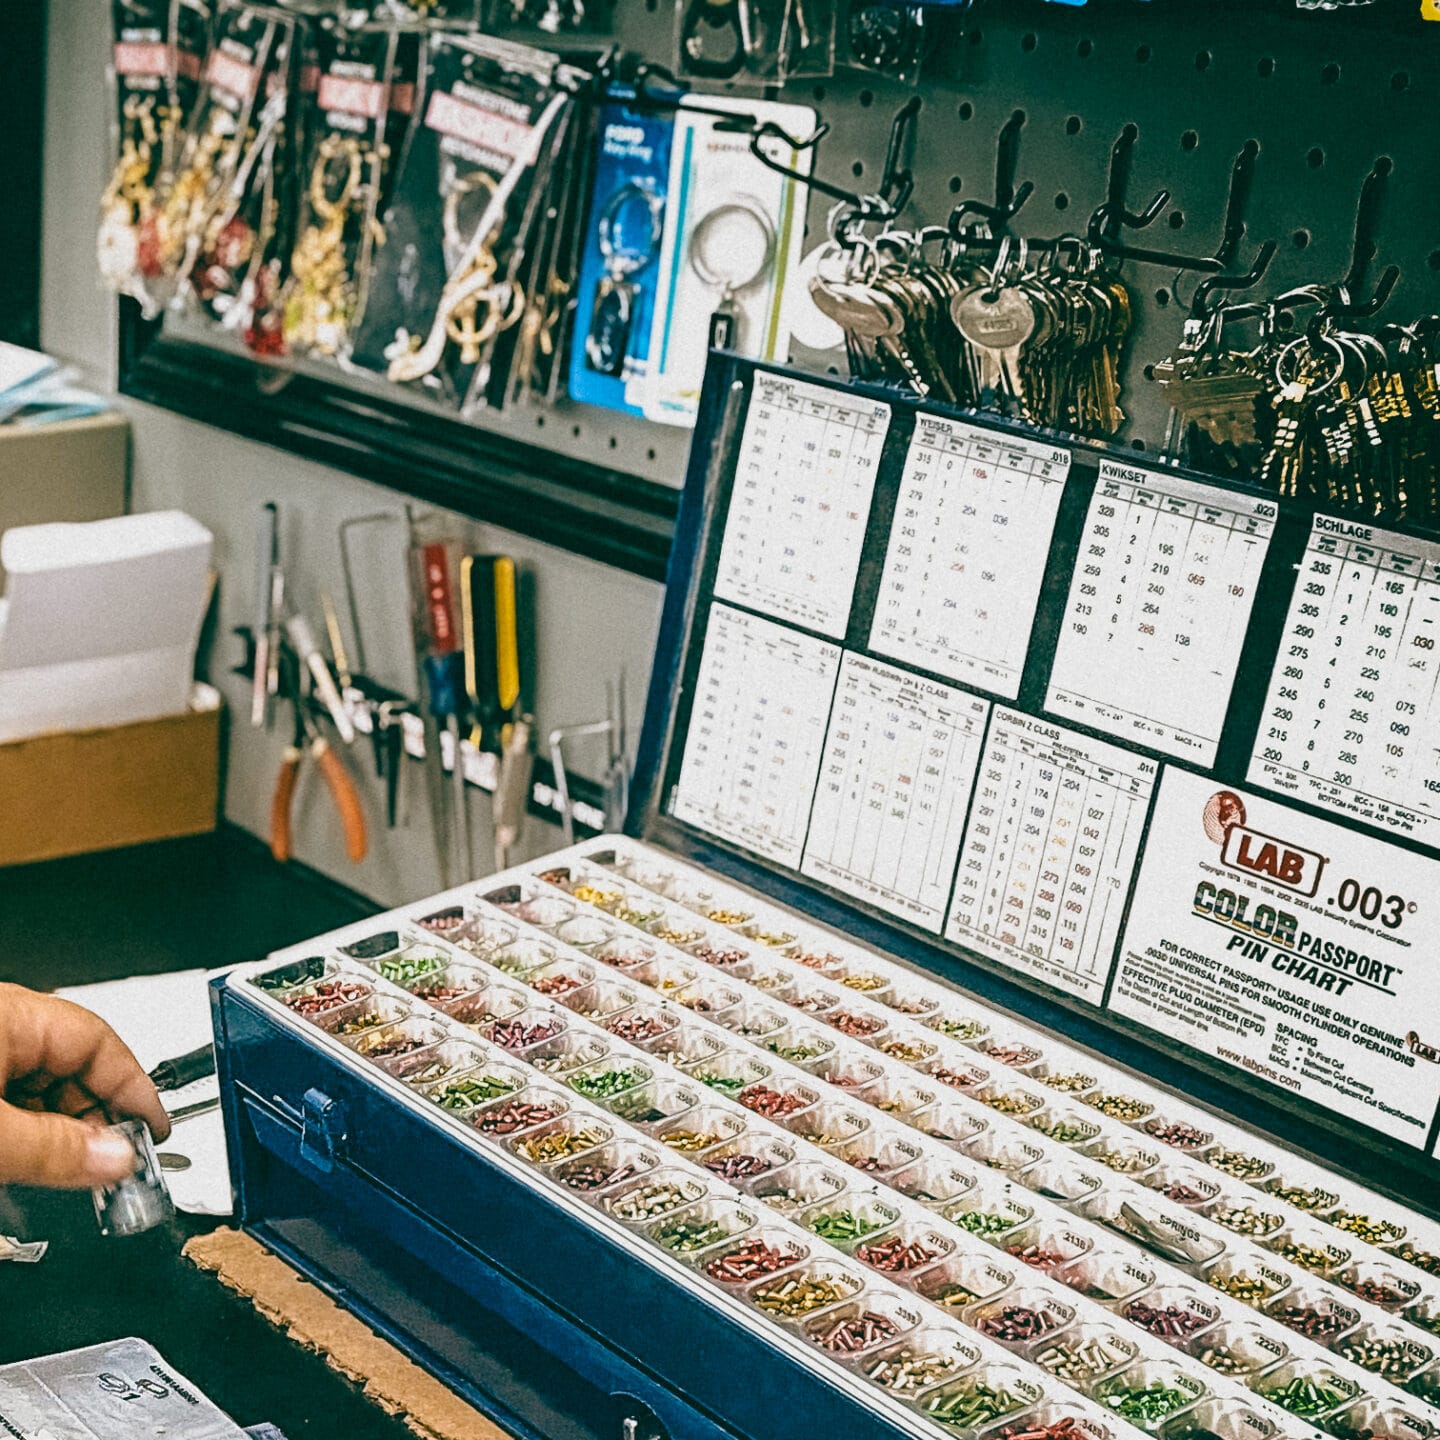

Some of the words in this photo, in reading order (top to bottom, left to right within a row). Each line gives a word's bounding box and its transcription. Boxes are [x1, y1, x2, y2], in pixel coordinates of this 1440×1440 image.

[920, 418, 953, 434] WEISER
[1101, 464, 1148, 485] KWIKSET
[1093, 525, 1110, 538] 305
[1315, 517, 1373, 542] SCHLAGE
[1151, 563, 1170, 576] 219
[1075, 603, 1092, 616] 213
[1072, 622, 1088, 635] 190
[1373, 624, 1392, 639] 195
[1365, 646, 1386, 660] 210
[1360, 667, 1380, 681] 225
[1033, 723, 1061, 741] CLASS
[1343, 731, 1364, 745] 270
[1338, 751, 1358, 765] 285
[1333, 772, 1352, 786] 300
[1236, 834, 1305, 884] LAB
[1193, 881, 1298, 949] COLOR
[1226, 935, 1268, 962] PIN
[1271, 953, 1354, 996] CHART
[1122, 966, 1168, 992] EFFECTIVE
[1169, 986, 1192, 1003] PLUG
[1194, 996, 1239, 1024] DIAMETER
[1240, 1016, 1265, 1036] (EPD)
[1160, 939, 1178, 953] FOR
[1180, 948, 1222, 971] CORRECT
[1277, 988, 1311, 1010] USAGE
[1312, 1002, 1331, 1018] USE
[1333, 1012, 1359, 1028] ONLY
[1360, 1023, 1405, 1048] GENUINE
[1416, 1045, 1437, 1060] LAB
[1169, 956, 1217, 984] UNIVERSAL
[1219, 977, 1239, 993] PINS
[1241, 987, 1260, 1001] FOR
[1262, 996, 1302, 1019] SMOOTH
[1303, 1013, 1350, 1040] CYLINDER
[1352, 1034, 1415, 1067] OPERATIONS
[1276, 1022, 1318, 1048] SPACING
[1271, 1044, 1287, 1056] BCC
[1333, 1071, 1346, 1082] Cut
[1274, 1034, 1290, 1046] TFC
[1315, 1052, 1331, 1064] First
[1332, 1059, 1345, 1070] Cut
[1217, 1046, 1301, 1090] www.labpins.com
[1269, 1054, 1291, 1069] MACS
[1333, 1084, 1363, 1102] Adjacent
[1364, 1096, 1378, 1107] Cut
[1378, 1102, 1426, 1129] Specifications
[1159, 1214, 1201, 1242] SPRINGS
